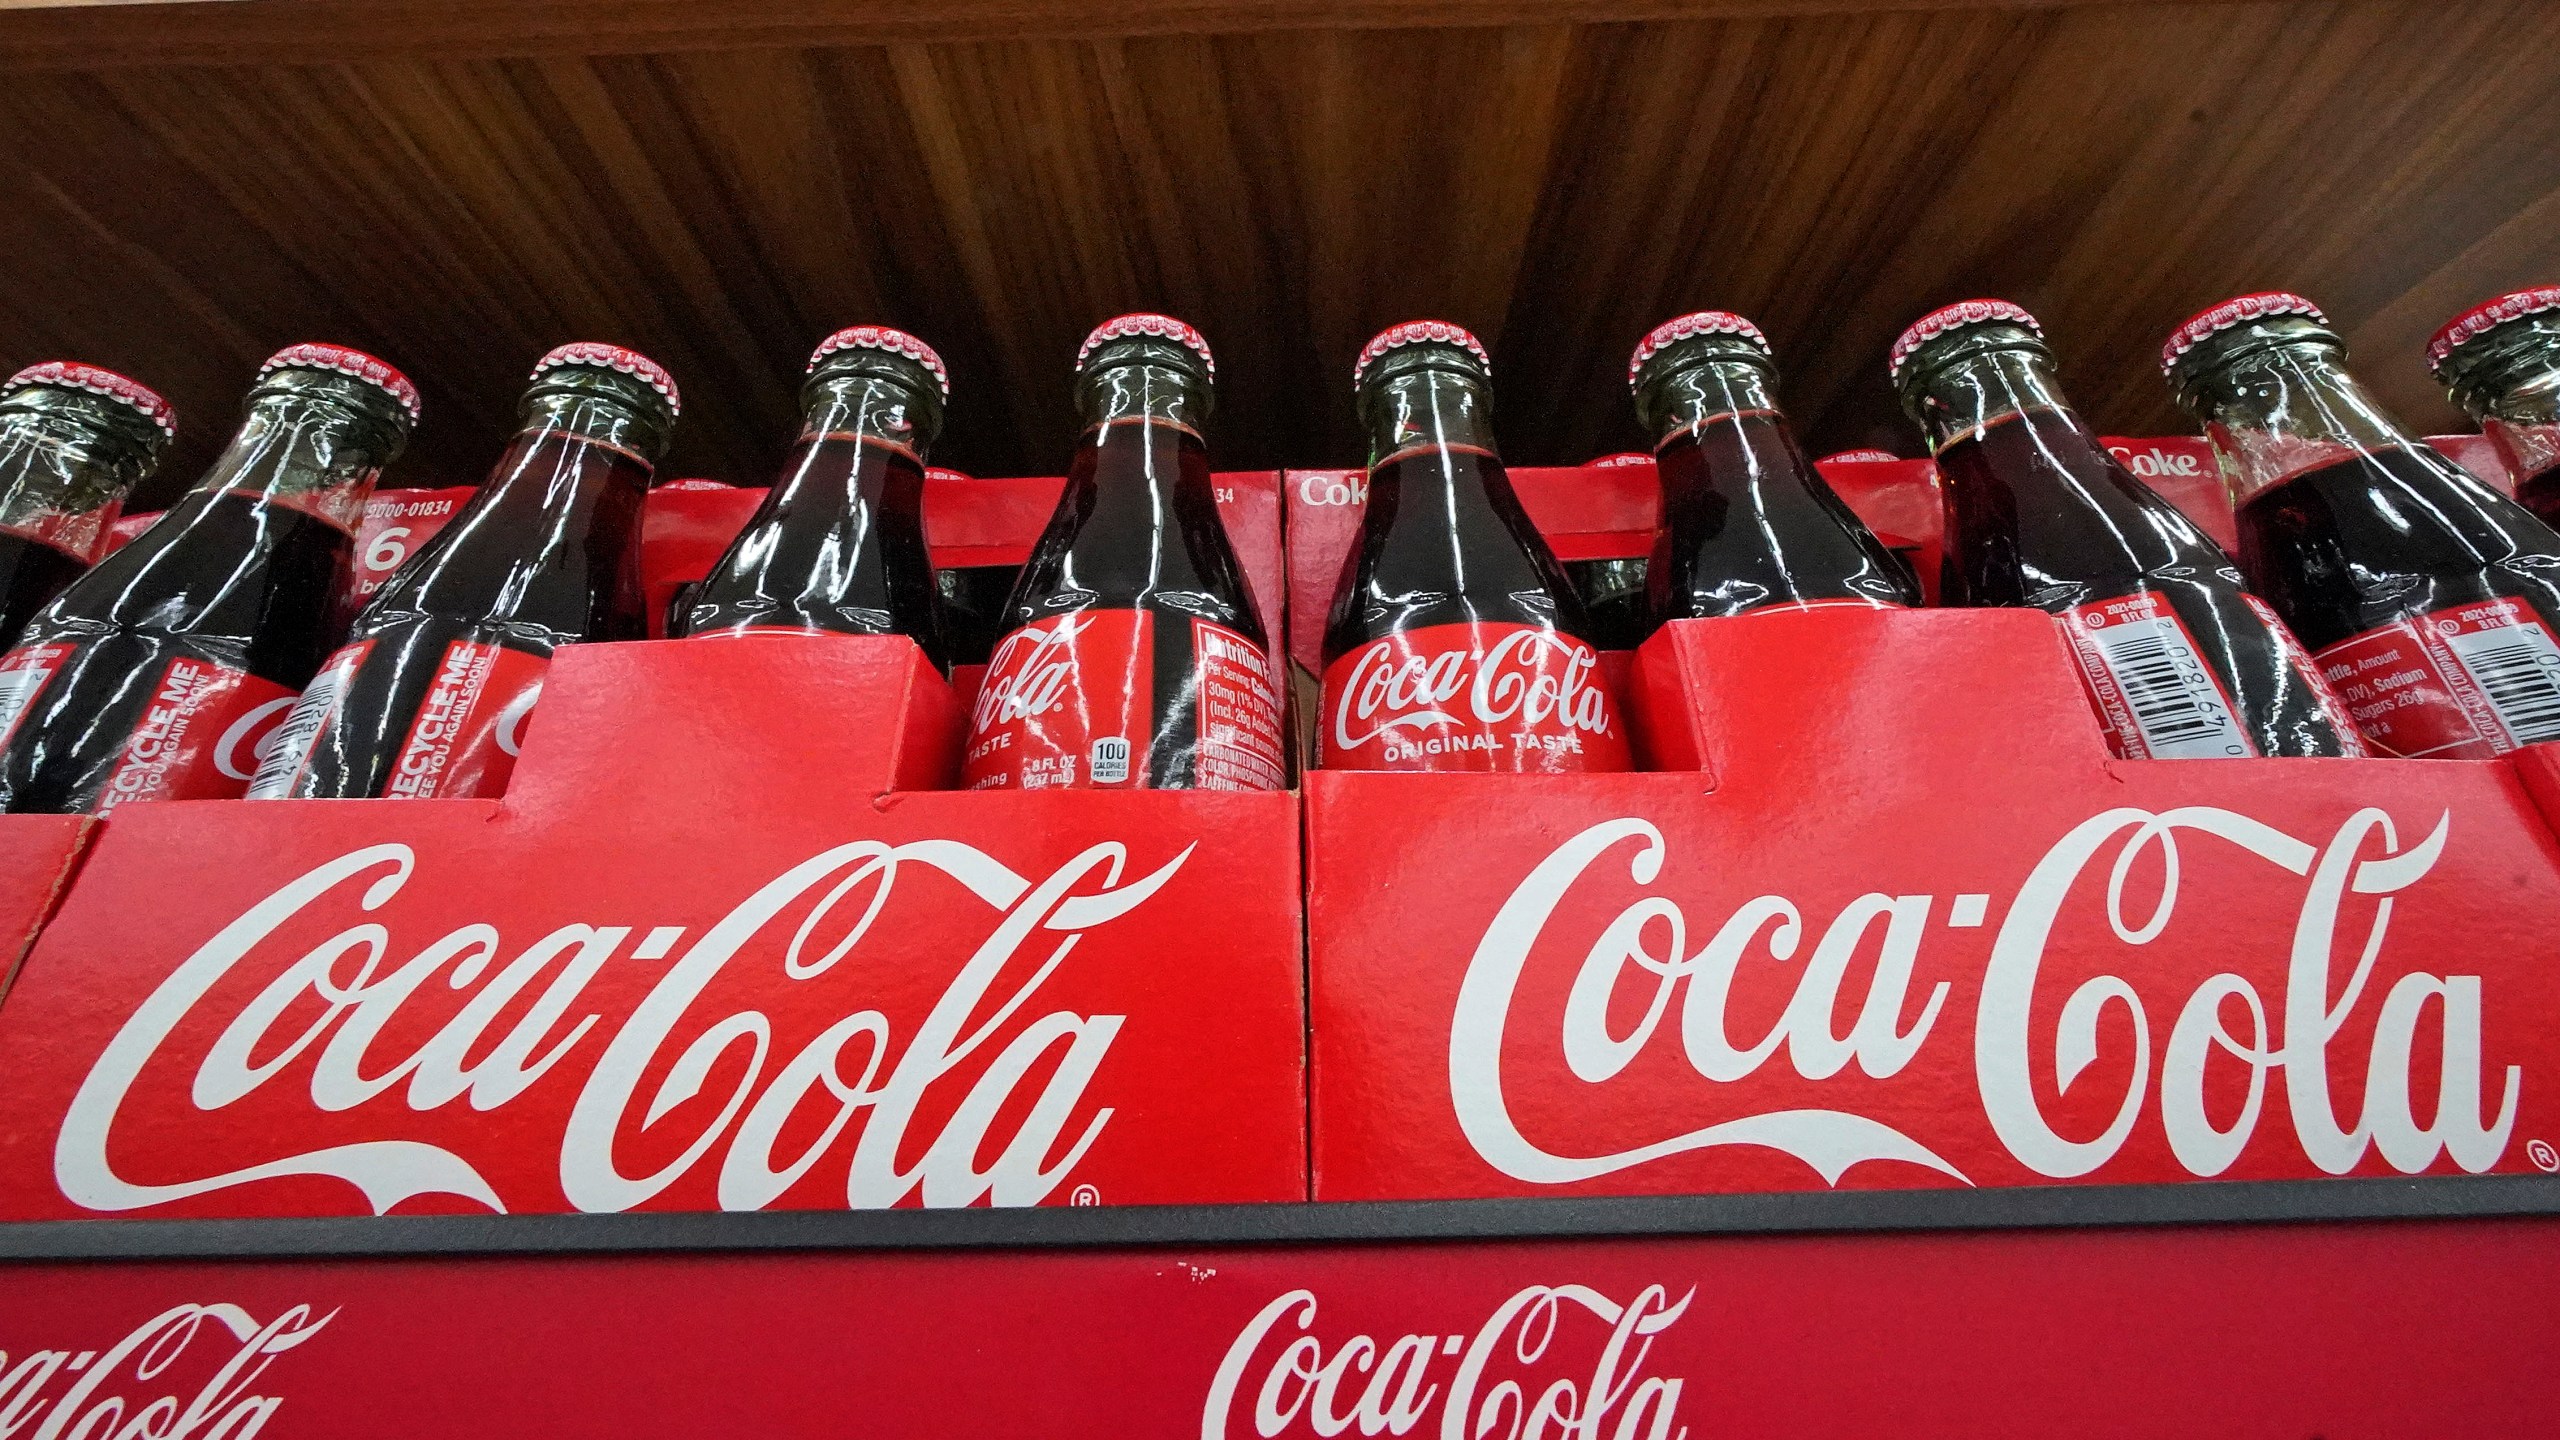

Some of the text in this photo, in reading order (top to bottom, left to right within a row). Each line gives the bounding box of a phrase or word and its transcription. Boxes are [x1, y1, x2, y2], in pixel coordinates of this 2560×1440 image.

[1300, 477, 1367, 506] Cok
[364, 500, 453, 519] 9000-01834
[365, 527, 412, 571] 6
[439, 646, 477, 685] ME
[1204, 632, 1263, 677] Nutrition
[1207, 661, 1222, 675] Per
[2358, 648, 2401, 671] Amount
[2430, 642, 2468, 686] COMPANY
[159, 662, 200, 704] ME
[1208, 680, 1236, 705] 30mg
[1336, 630, 1609, 750] Coca-Cola
[2374, 669, 2427, 693] Sodium
[2352, 698, 2396, 721] Sugars
[164, 719, 190, 767] AGAIN
[427, 744, 450, 775] YOU
[446, 700, 468, 743] AGAIN
[968, 732, 1012, 764] TASTE
[1097, 743, 1126, 760] 100
[1384, 733, 1584, 762] ORIGINAL TASTE
[1042, 757, 1057, 771] FL
[1059, 755, 1077, 769] OZ
[1094, 761, 1126, 770] CALORIES
[1449, 805, 2521, 1188] Coca-Cola
[55, 840, 1198, 1215] Coca-Cola
[1201, 1284, 1697, 1440] Coca-Cola
